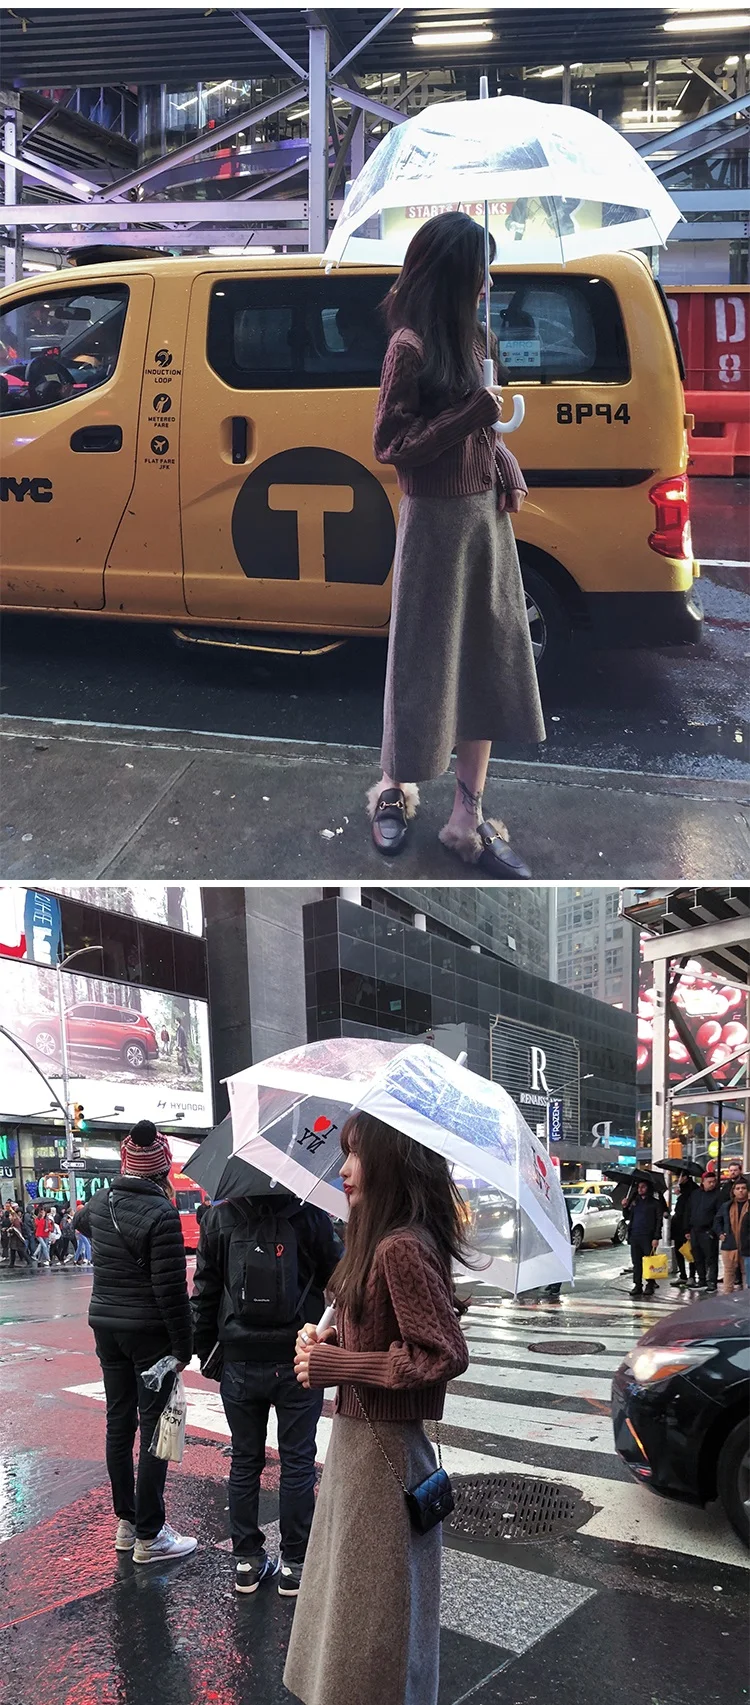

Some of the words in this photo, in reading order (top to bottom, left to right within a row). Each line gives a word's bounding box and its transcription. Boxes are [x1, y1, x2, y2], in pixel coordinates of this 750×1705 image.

[715, 297, 746, 343] D
[718, 354, 741, 382] 8
[557, 403, 631, 424] 8P94
[267, 483, 354, 582] T
[530, 1046, 554, 1093] R
[170, 1102, 205, 1112] HYUNDAI
